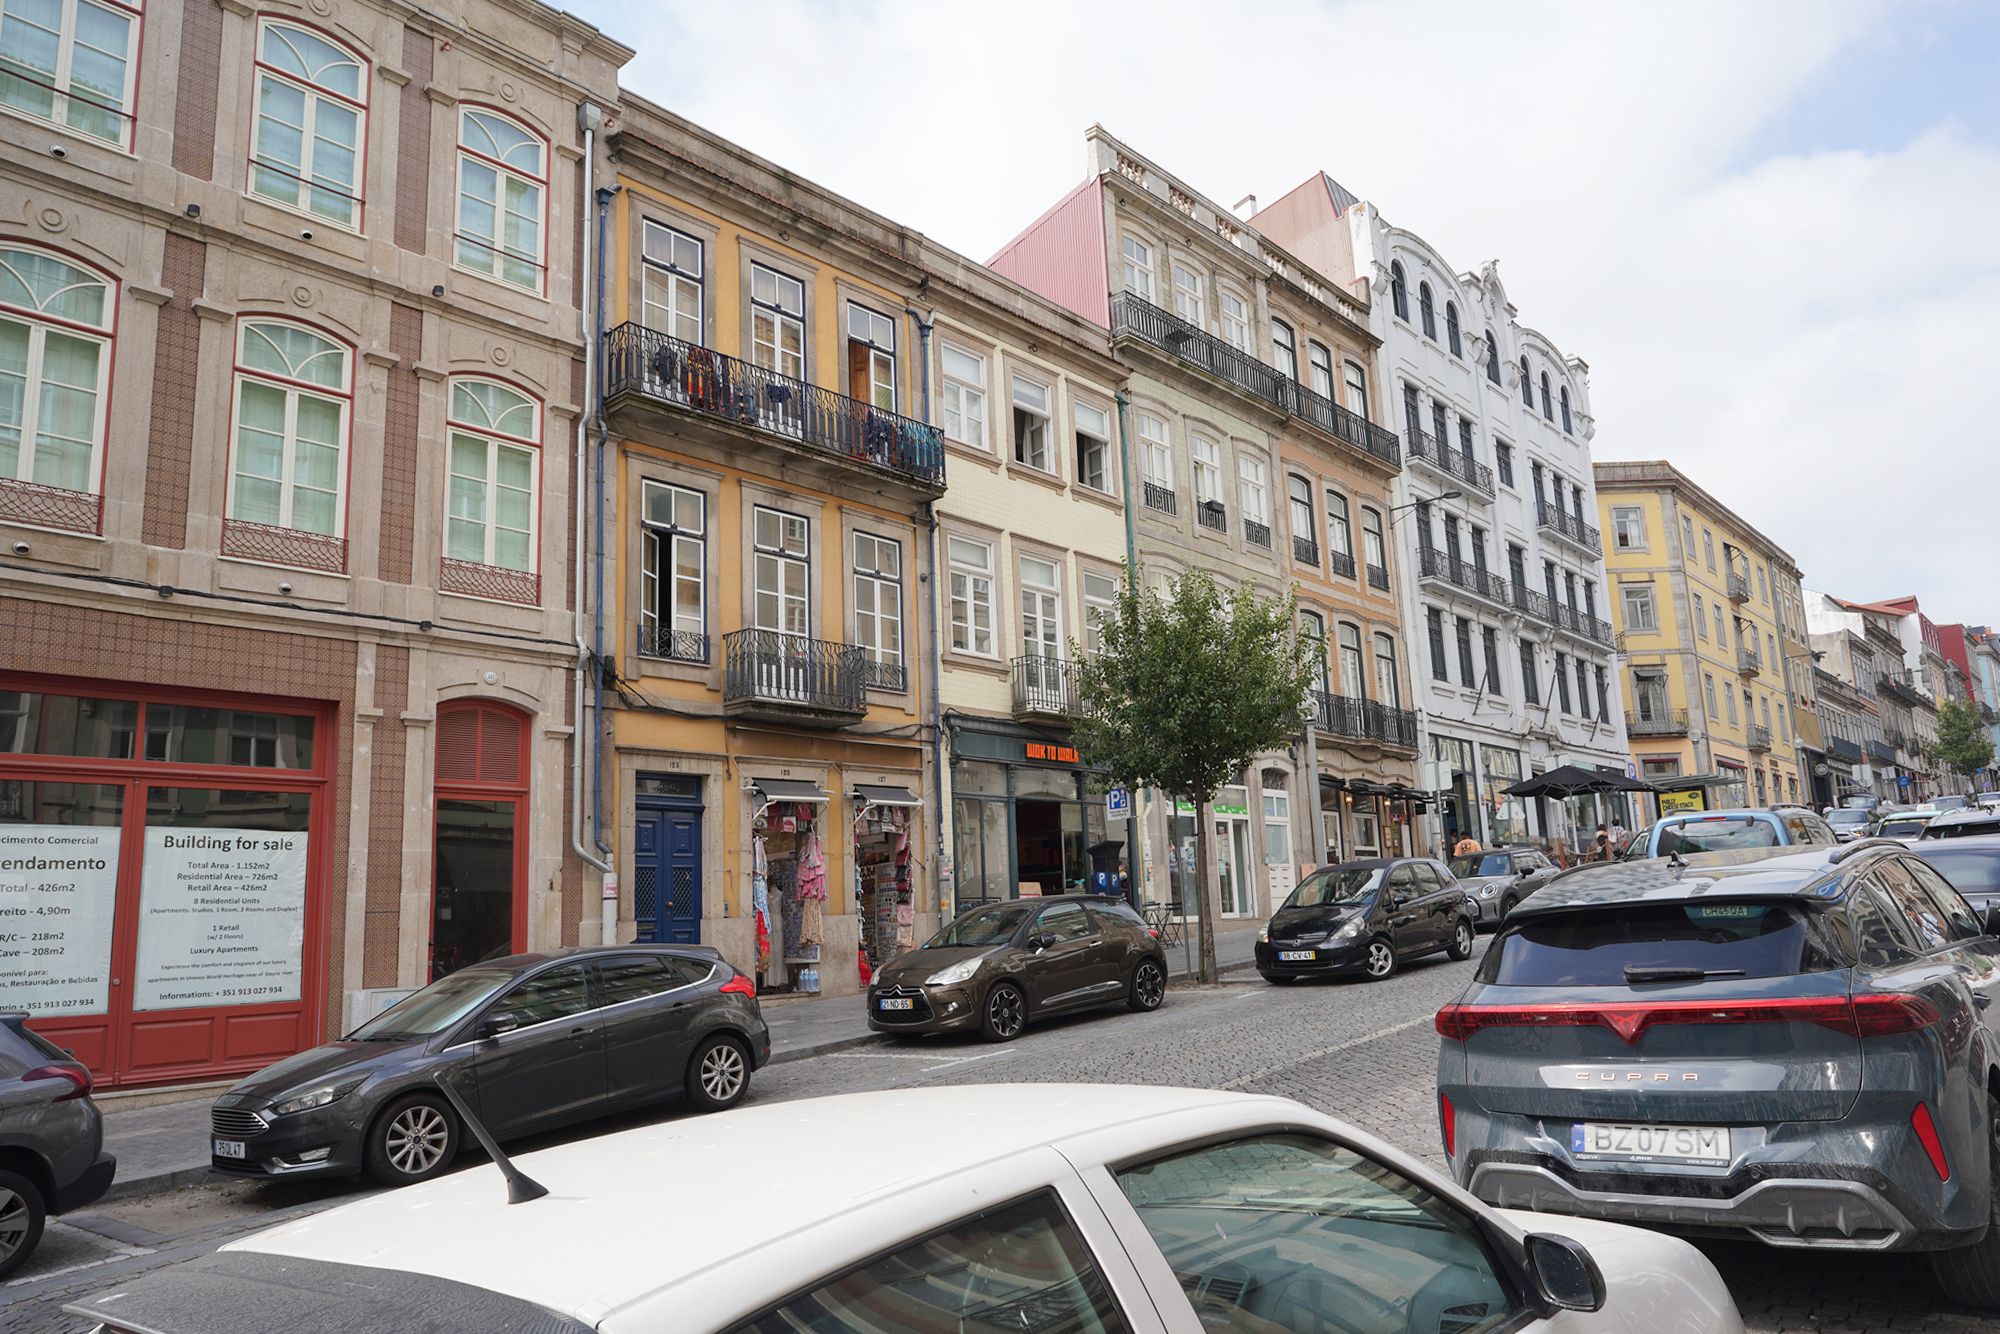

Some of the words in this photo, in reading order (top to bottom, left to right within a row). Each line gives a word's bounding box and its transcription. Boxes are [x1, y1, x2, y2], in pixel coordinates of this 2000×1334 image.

[1026, 743, 1046, 759] WOK
[1047, 745, 1057, 760] TO
[1057, 747, 1079, 763] WALK
[1110, 791, 1120, 809] P
[0, 836, 45, 844] cimento
[48, 836, 99, 845] Comercial
[164, 835, 232, 852] Building
[236, 837, 259, 850] for
[263, 838, 293, 851] sale
[0, 856, 106, 870] endamento
[188, 861, 209, 869] Total
[236, 862, 270, 870] 1.152m2
[252, 873, 279, 881] 726m2
[38, 883, 75, 893] 426m2
[187, 884, 212, 892] Retail
[36, 906, 71, 916] 4,90m
[31, 932, 65, 941] 218m2
[31, 947, 65, 956] 208m2
[190, 947, 214, 955] Luxury
[216, 945, 259, 954] Apartments
[10, 978, 59, 988] Restauração
[68, 976, 98, 984] Bebidas
[159, 991, 214, 1000] Informations:
[237, 988, 252, 996] 913
[253, 987, 267, 995] 027
[269, 986, 283, 994] 934
[27, 1002, 42, 1010] 351
[44, 1001, 60, 1009] 913
[1575, 1072, 1699, 1081] CUPRA
